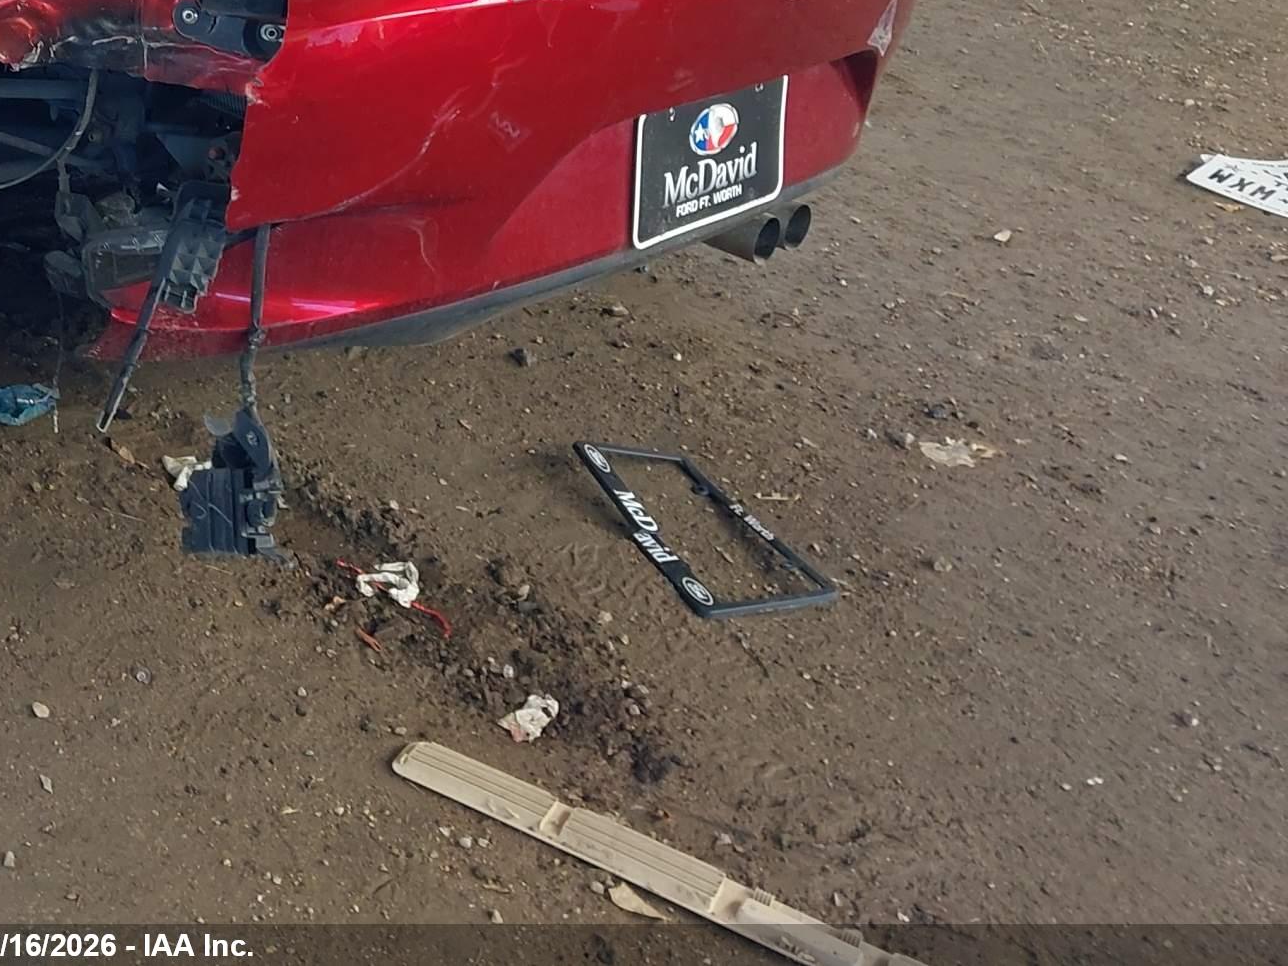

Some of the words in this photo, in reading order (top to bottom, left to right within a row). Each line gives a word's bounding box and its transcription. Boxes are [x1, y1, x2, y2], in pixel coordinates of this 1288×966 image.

[663, 141, 758, 208] McDavid
[675, 201, 698, 218] FORD
[699, 198, 711, 209] FT.
[713, 183, 743, 204] WORTH
[612, 488, 680, 564] McDavid
